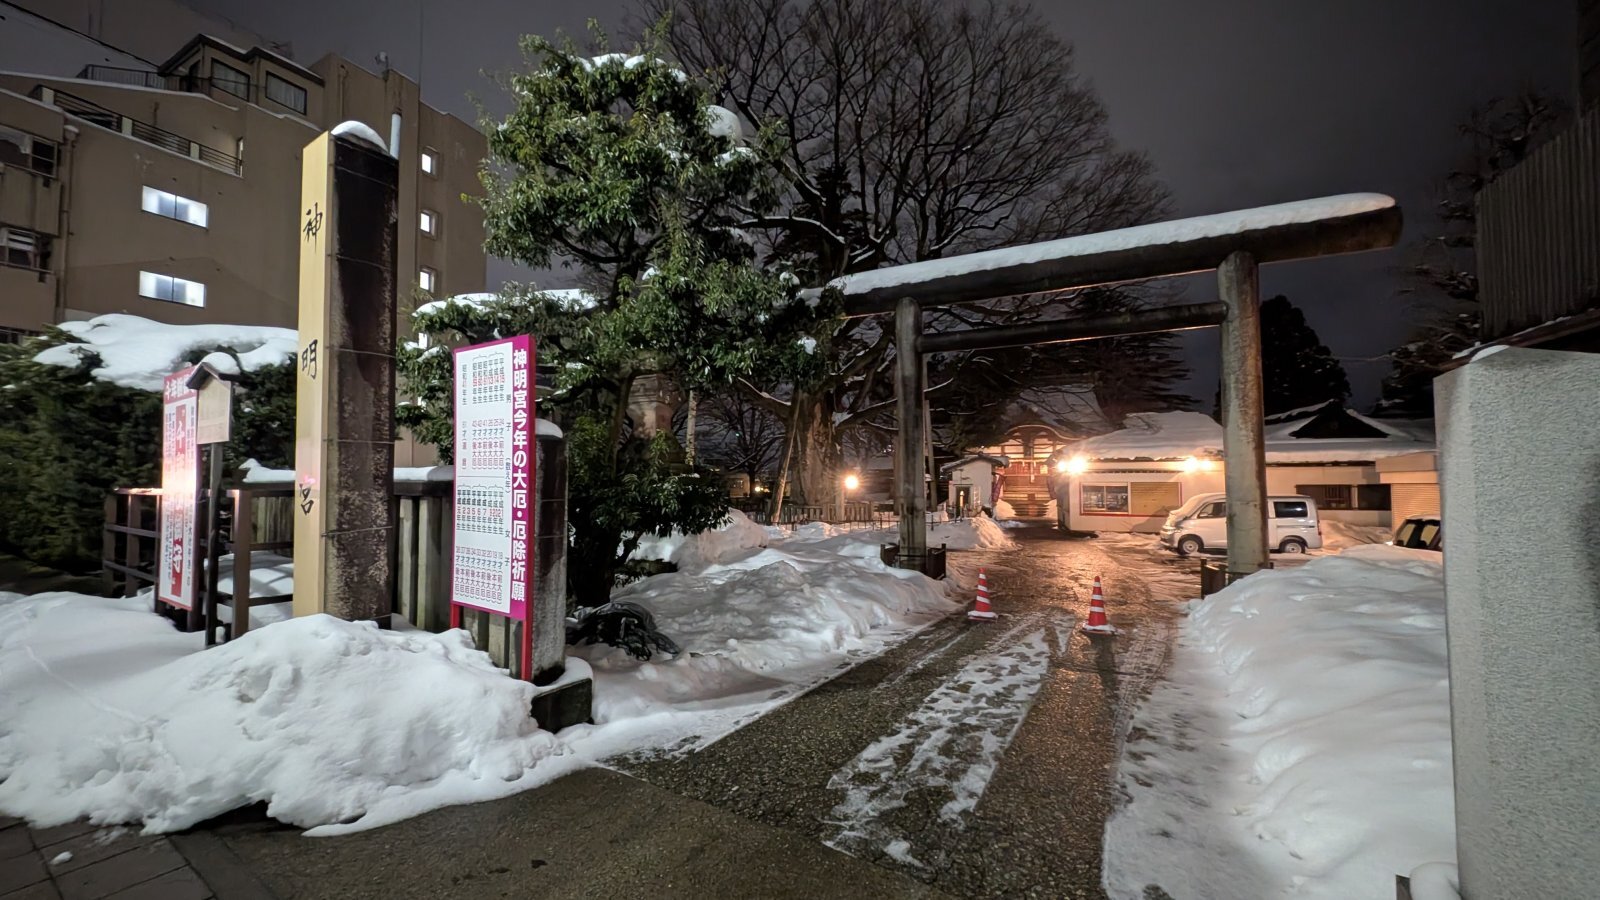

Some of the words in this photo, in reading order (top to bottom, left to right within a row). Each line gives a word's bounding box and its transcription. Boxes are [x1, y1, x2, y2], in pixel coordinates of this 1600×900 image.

[298, 202, 323, 516] 神明宮
[512, 349, 527, 602] 神明宮今年の大厄・厄除祈願
